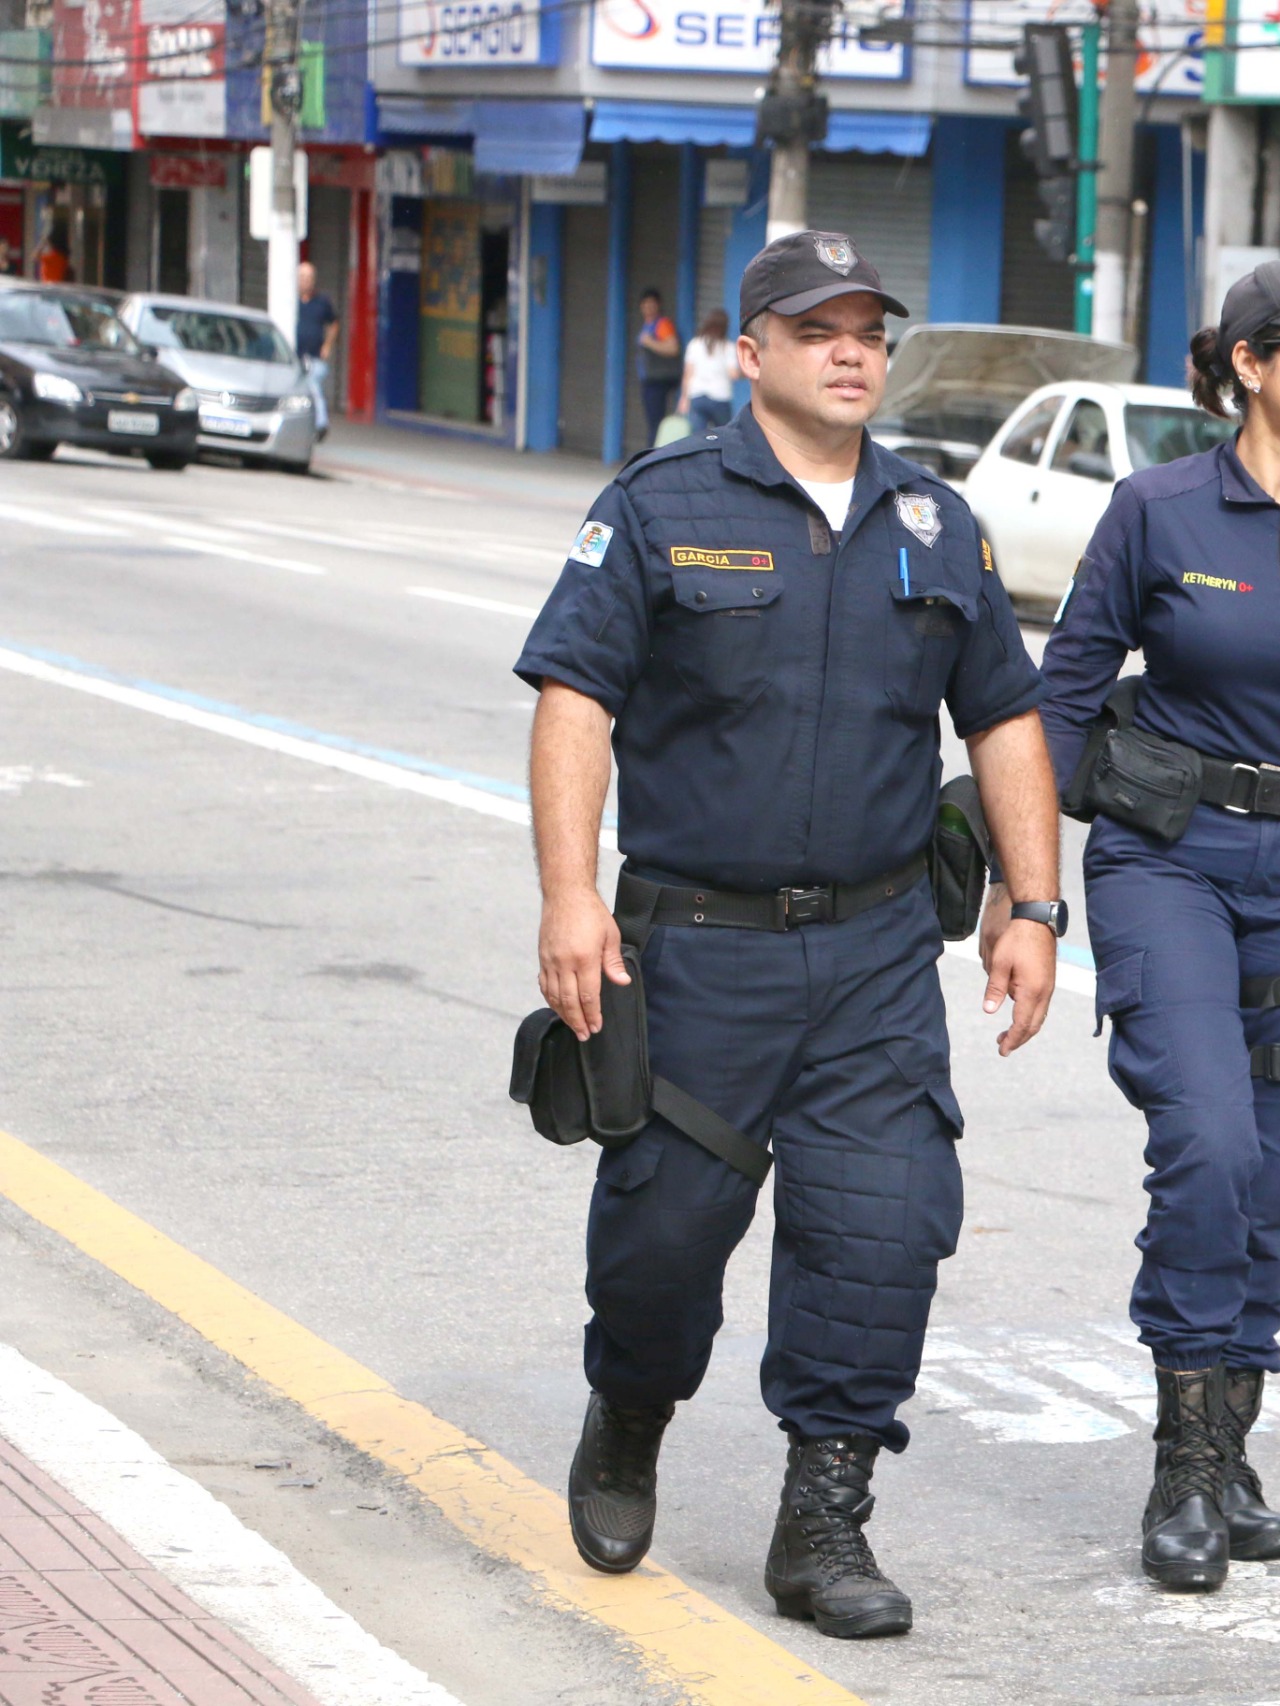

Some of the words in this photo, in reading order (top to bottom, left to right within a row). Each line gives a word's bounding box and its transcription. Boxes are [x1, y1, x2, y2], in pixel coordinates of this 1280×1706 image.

[442, 4, 523, 55] SERGIO
[674, 12, 895, 52] SERI
[677, 551, 730, 565] GARCIA
[1182, 571, 1237, 592] KETHERYN
